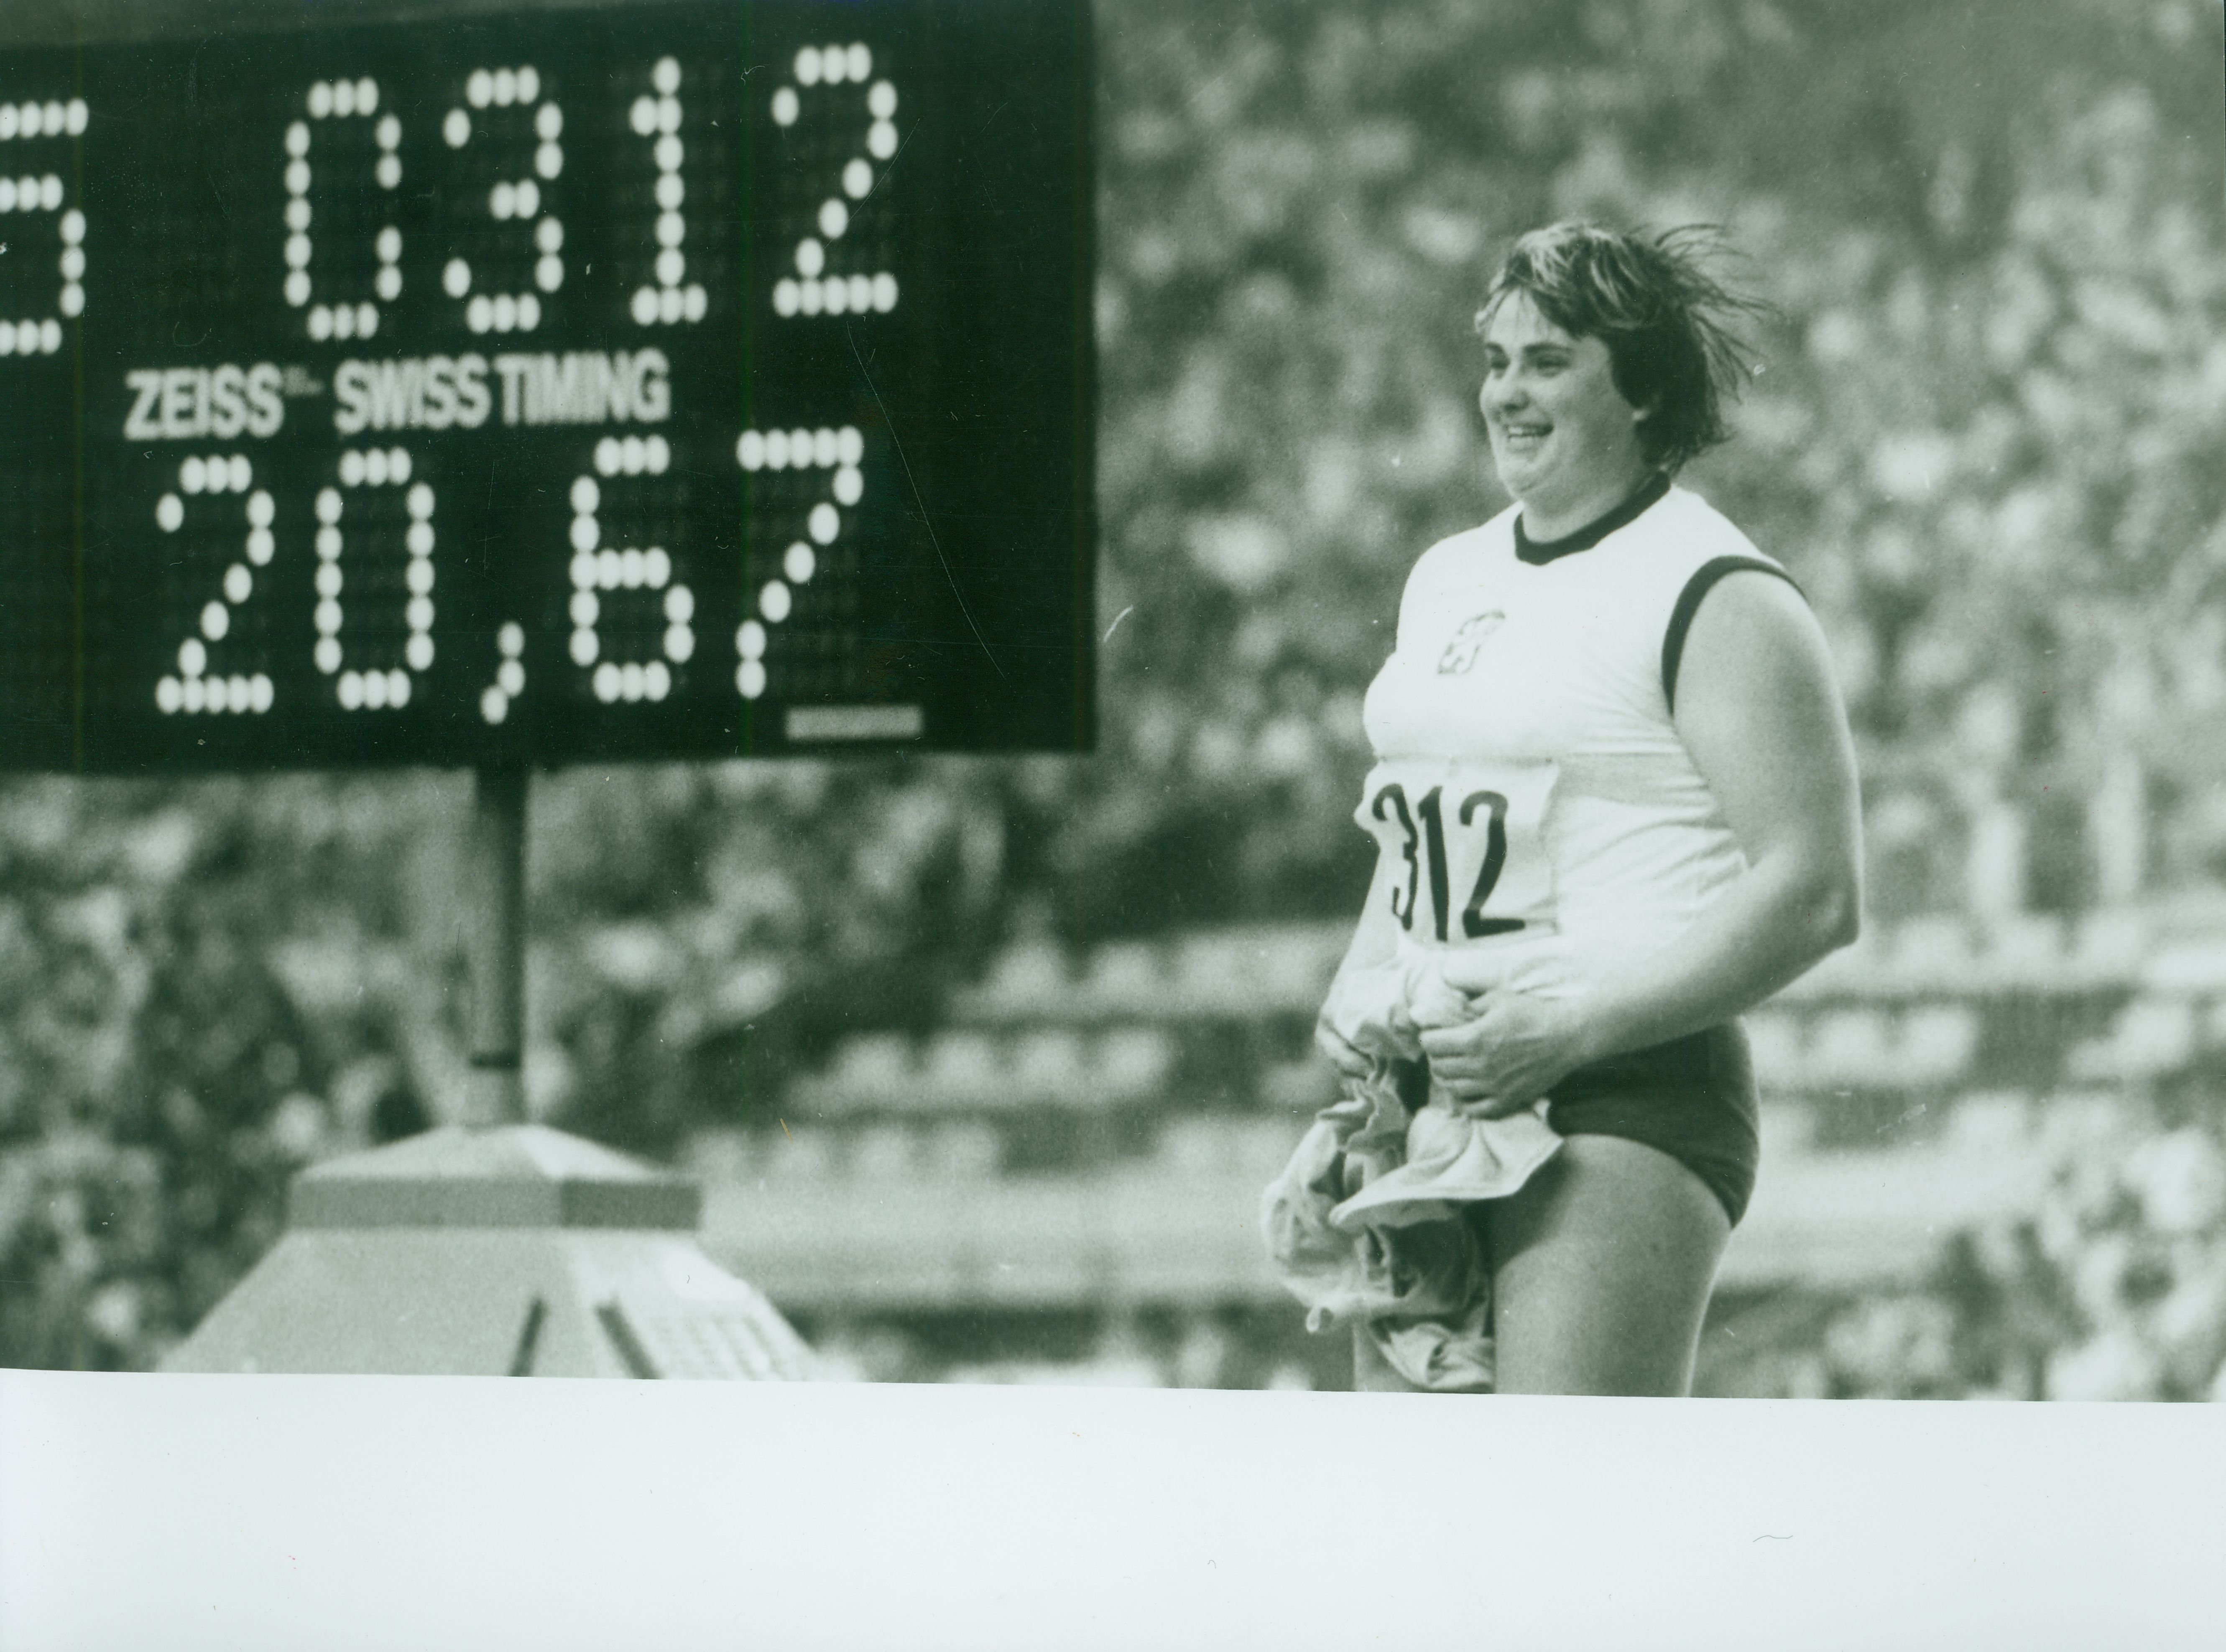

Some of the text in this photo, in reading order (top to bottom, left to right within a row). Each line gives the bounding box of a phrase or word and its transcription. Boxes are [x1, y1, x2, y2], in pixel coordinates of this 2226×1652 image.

[284, 43, 898, 341] 0312
[124, 363, 284, 440] ZEISS
[334, 354, 492, 434] SWISS
[493, 348, 670, 424] TIMING
[156, 426, 864, 724] 20,67
[1371, 783, 1527, 943] 312
